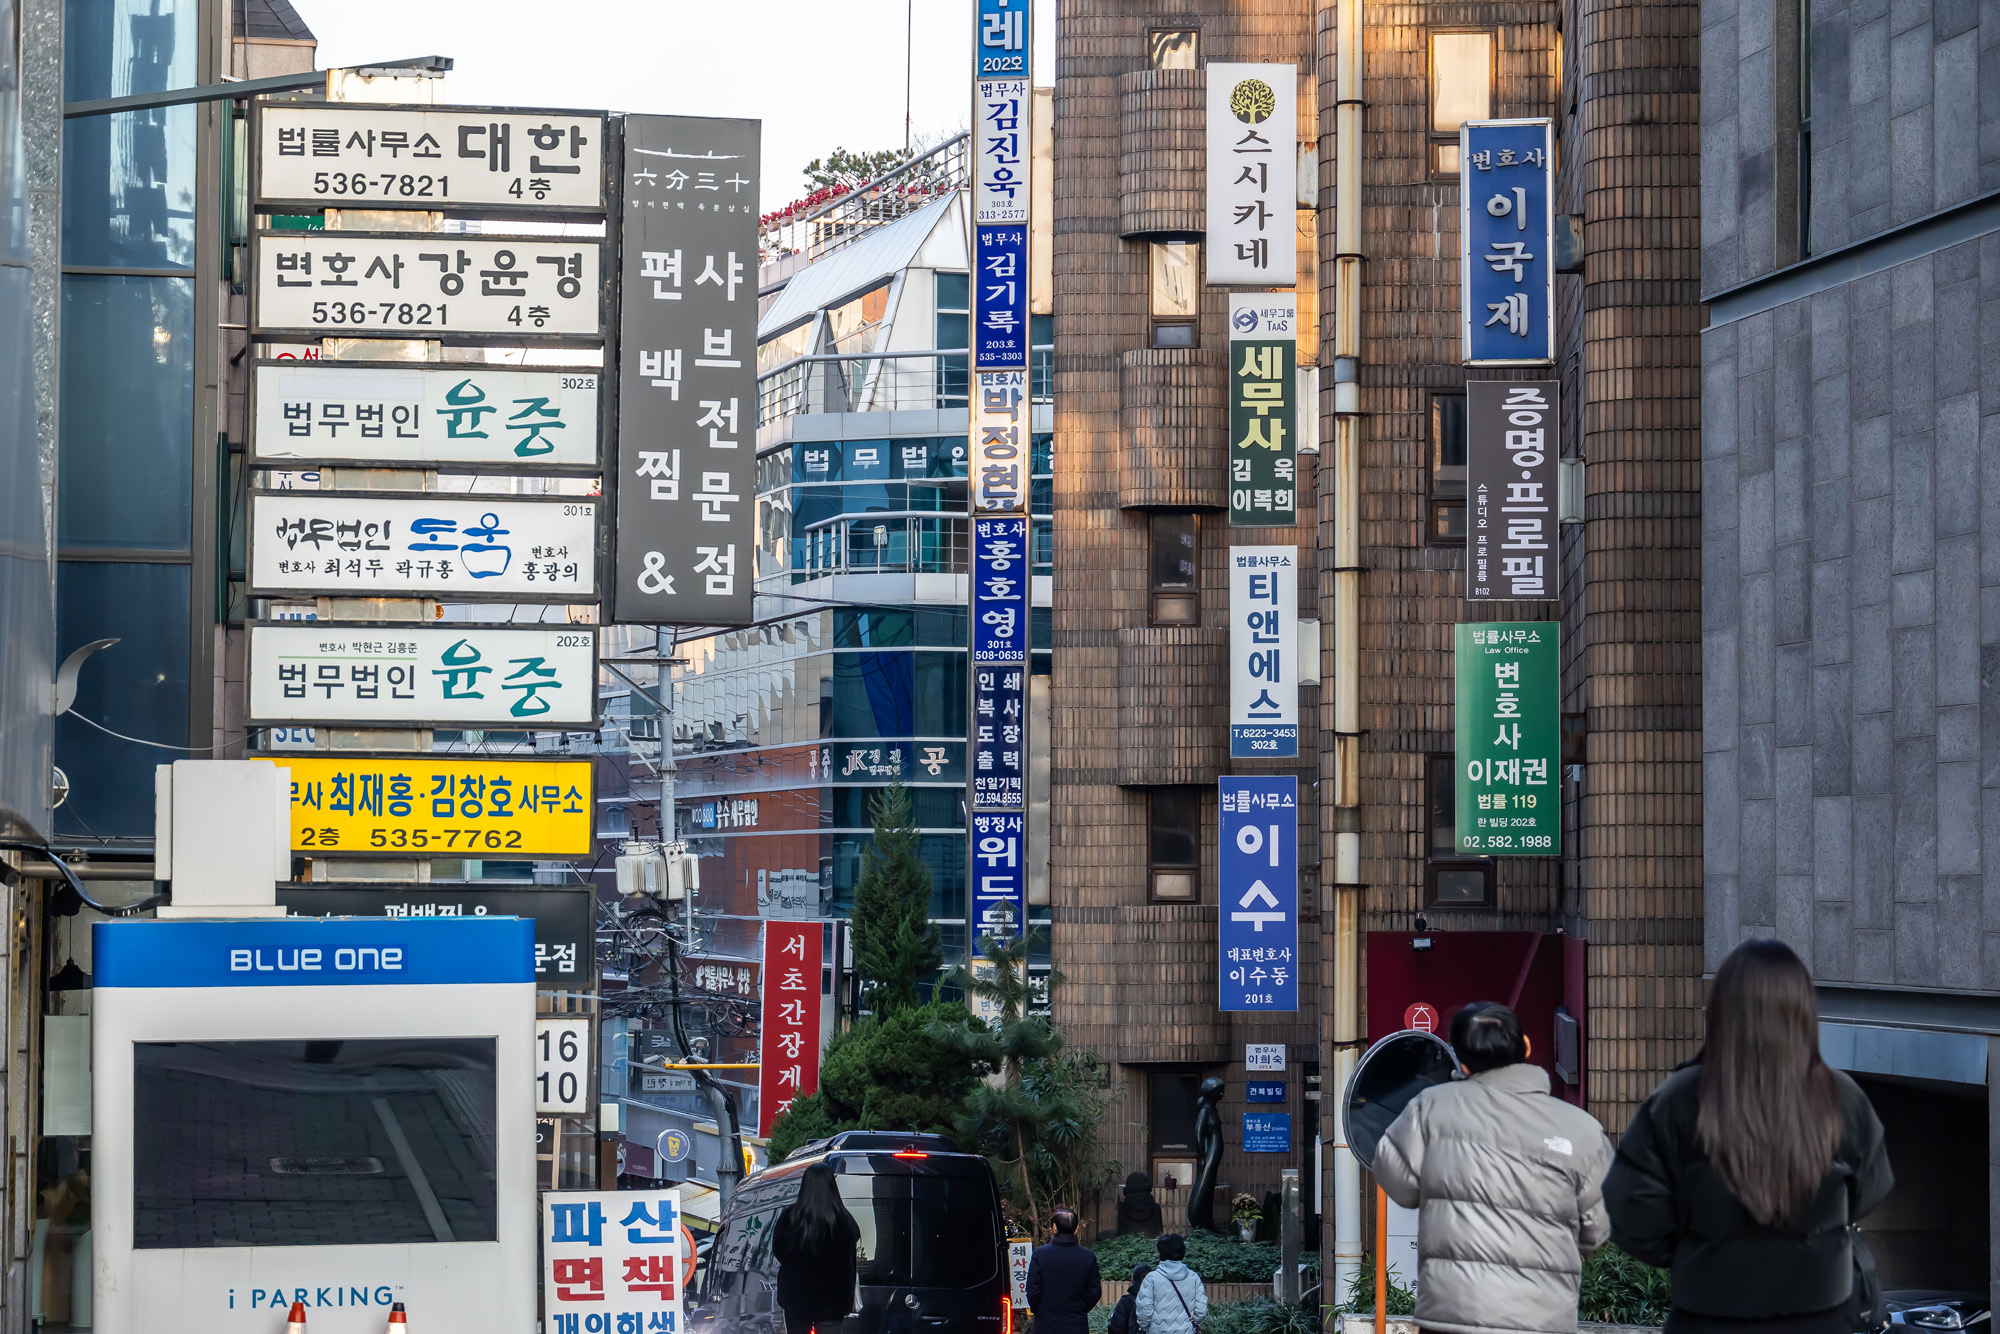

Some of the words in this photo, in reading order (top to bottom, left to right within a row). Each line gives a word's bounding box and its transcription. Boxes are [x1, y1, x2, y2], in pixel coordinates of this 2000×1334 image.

[982, 0, 1024, 50] 레
[983, 56, 1022, 73] 202호
[979, 80, 1025, 97] 법무사
[279, 128, 441, 158] 법률사무소
[458, 123, 587, 174] 대한
[984, 99, 1022, 198] 김진욱
[1470, 147, 1546, 172] 변호사
[313, 172, 450, 198] 536-7821
[509, 178, 551, 200] 4층
[633, 168, 749, 192] 六分三十
[1233, 130, 1273, 269] 스시카네
[979, 210, 1024, 219] 313-2577
[982, 232, 1022, 246] 법무사
[1484, 186, 1535, 338] 이국재
[277, 252, 404, 289] 변호사
[419, 250, 582, 298] 강윤경
[983, 253, 1019, 333] 김기록
[311, 302, 449, 326] 536-7821
[508, 305, 550, 327] 4층
[1260, 309, 1293, 318] 세무그룹
[987, 340, 1016, 348] 203호
[980, 352, 1022, 360] 535-3303
[561, 377, 596, 390] 302호
[636, 249, 681, 500] 편백찜
[980, 372, 1024, 386] 변호사
[1238, 347, 1286, 451] 세무사
[284, 403, 418, 438] 법무법인
[436, 378, 568, 457] 윤중
[693, 252, 743, 595] 샤브전문점
[982, 388, 1023, 498] 박정현
[985, 499, 1016, 512] 2층
[1233, 489, 1293, 511] 이복희
[1477, 484, 1487, 527] 스튜디오
[563, 505, 593, 517] 301호
[978, 521, 1026, 537] 변호사
[276, 518, 391, 551] 법무법인
[406, 513, 511, 579] 도움
[532, 546, 568, 559] 변호사
[279, 560, 315, 573] 변호사
[325, 559, 383, 577] 최석두
[396, 560, 453, 579] 곽규홍
[1237, 556, 1291, 567] 법률사무소
[522, 562, 577, 582] 홍광의
[637, 551, 676, 594] &
[979, 541, 1021, 637] 홍호영
[320, 643, 345, 652] 변호사
[353, 642, 382, 652] 박현근
[557, 636, 589, 646] 202호
[1247, 572, 1281, 718] 티앤에스
[1472, 630, 1540, 644] 법률사무소
[976, 651, 1023, 659] 508-0635
[279, 664, 414, 699] 법무법인
[432, 636, 563, 717] 윤중
[979, 673, 1020, 690] 인쇄
[978, 699, 1020, 718] 복사
[1494, 662, 1521, 750] 변호사
[978, 725, 1020, 743] 도장
[1234, 727, 1298, 740] T.6223-3453
[1252, 740, 1278, 749] 302호
[977, 751, 1018, 769] 출력
[1468, 758, 1547, 785] 이재권
[975, 777, 1020, 791] 천일기획
[330, 772, 513, 818] 최재홍·김창호
[519, 785, 583, 813] 사무소
[973, 793, 1023, 805] 02.594.3555
[1221, 789, 1296, 814] 법률사무소
[1478, 794, 1507, 809] 법률
[1512, 795, 1536, 808] 119
[975, 817, 1024, 833] 행정사
[1490, 818, 1507, 827] 빌딩
[1511, 818, 1536, 826] 202호
[301, 828, 339, 846] 2층
[370, 828, 523, 849] 535-7762
[1464, 836, 1551, 848] 02.582.1988
[1231, 825, 1285, 931] 이수
[1227, 947, 1291, 962] 대표변호사
[1230, 967, 1288, 986] 이수동
[1246, 994, 1272, 1003] 201호
[537, 1028, 580, 1064] 16
[1248, 1055, 1283, 1064] 이희숙
[537, 1071, 580, 1105] 10
[1246, 1122, 1271, 1131] 부동산
[549, 1199, 679, 1247] 파산
[551, 1254, 676, 1302] 면책
[250, 1285, 394, 1308] PARKING
